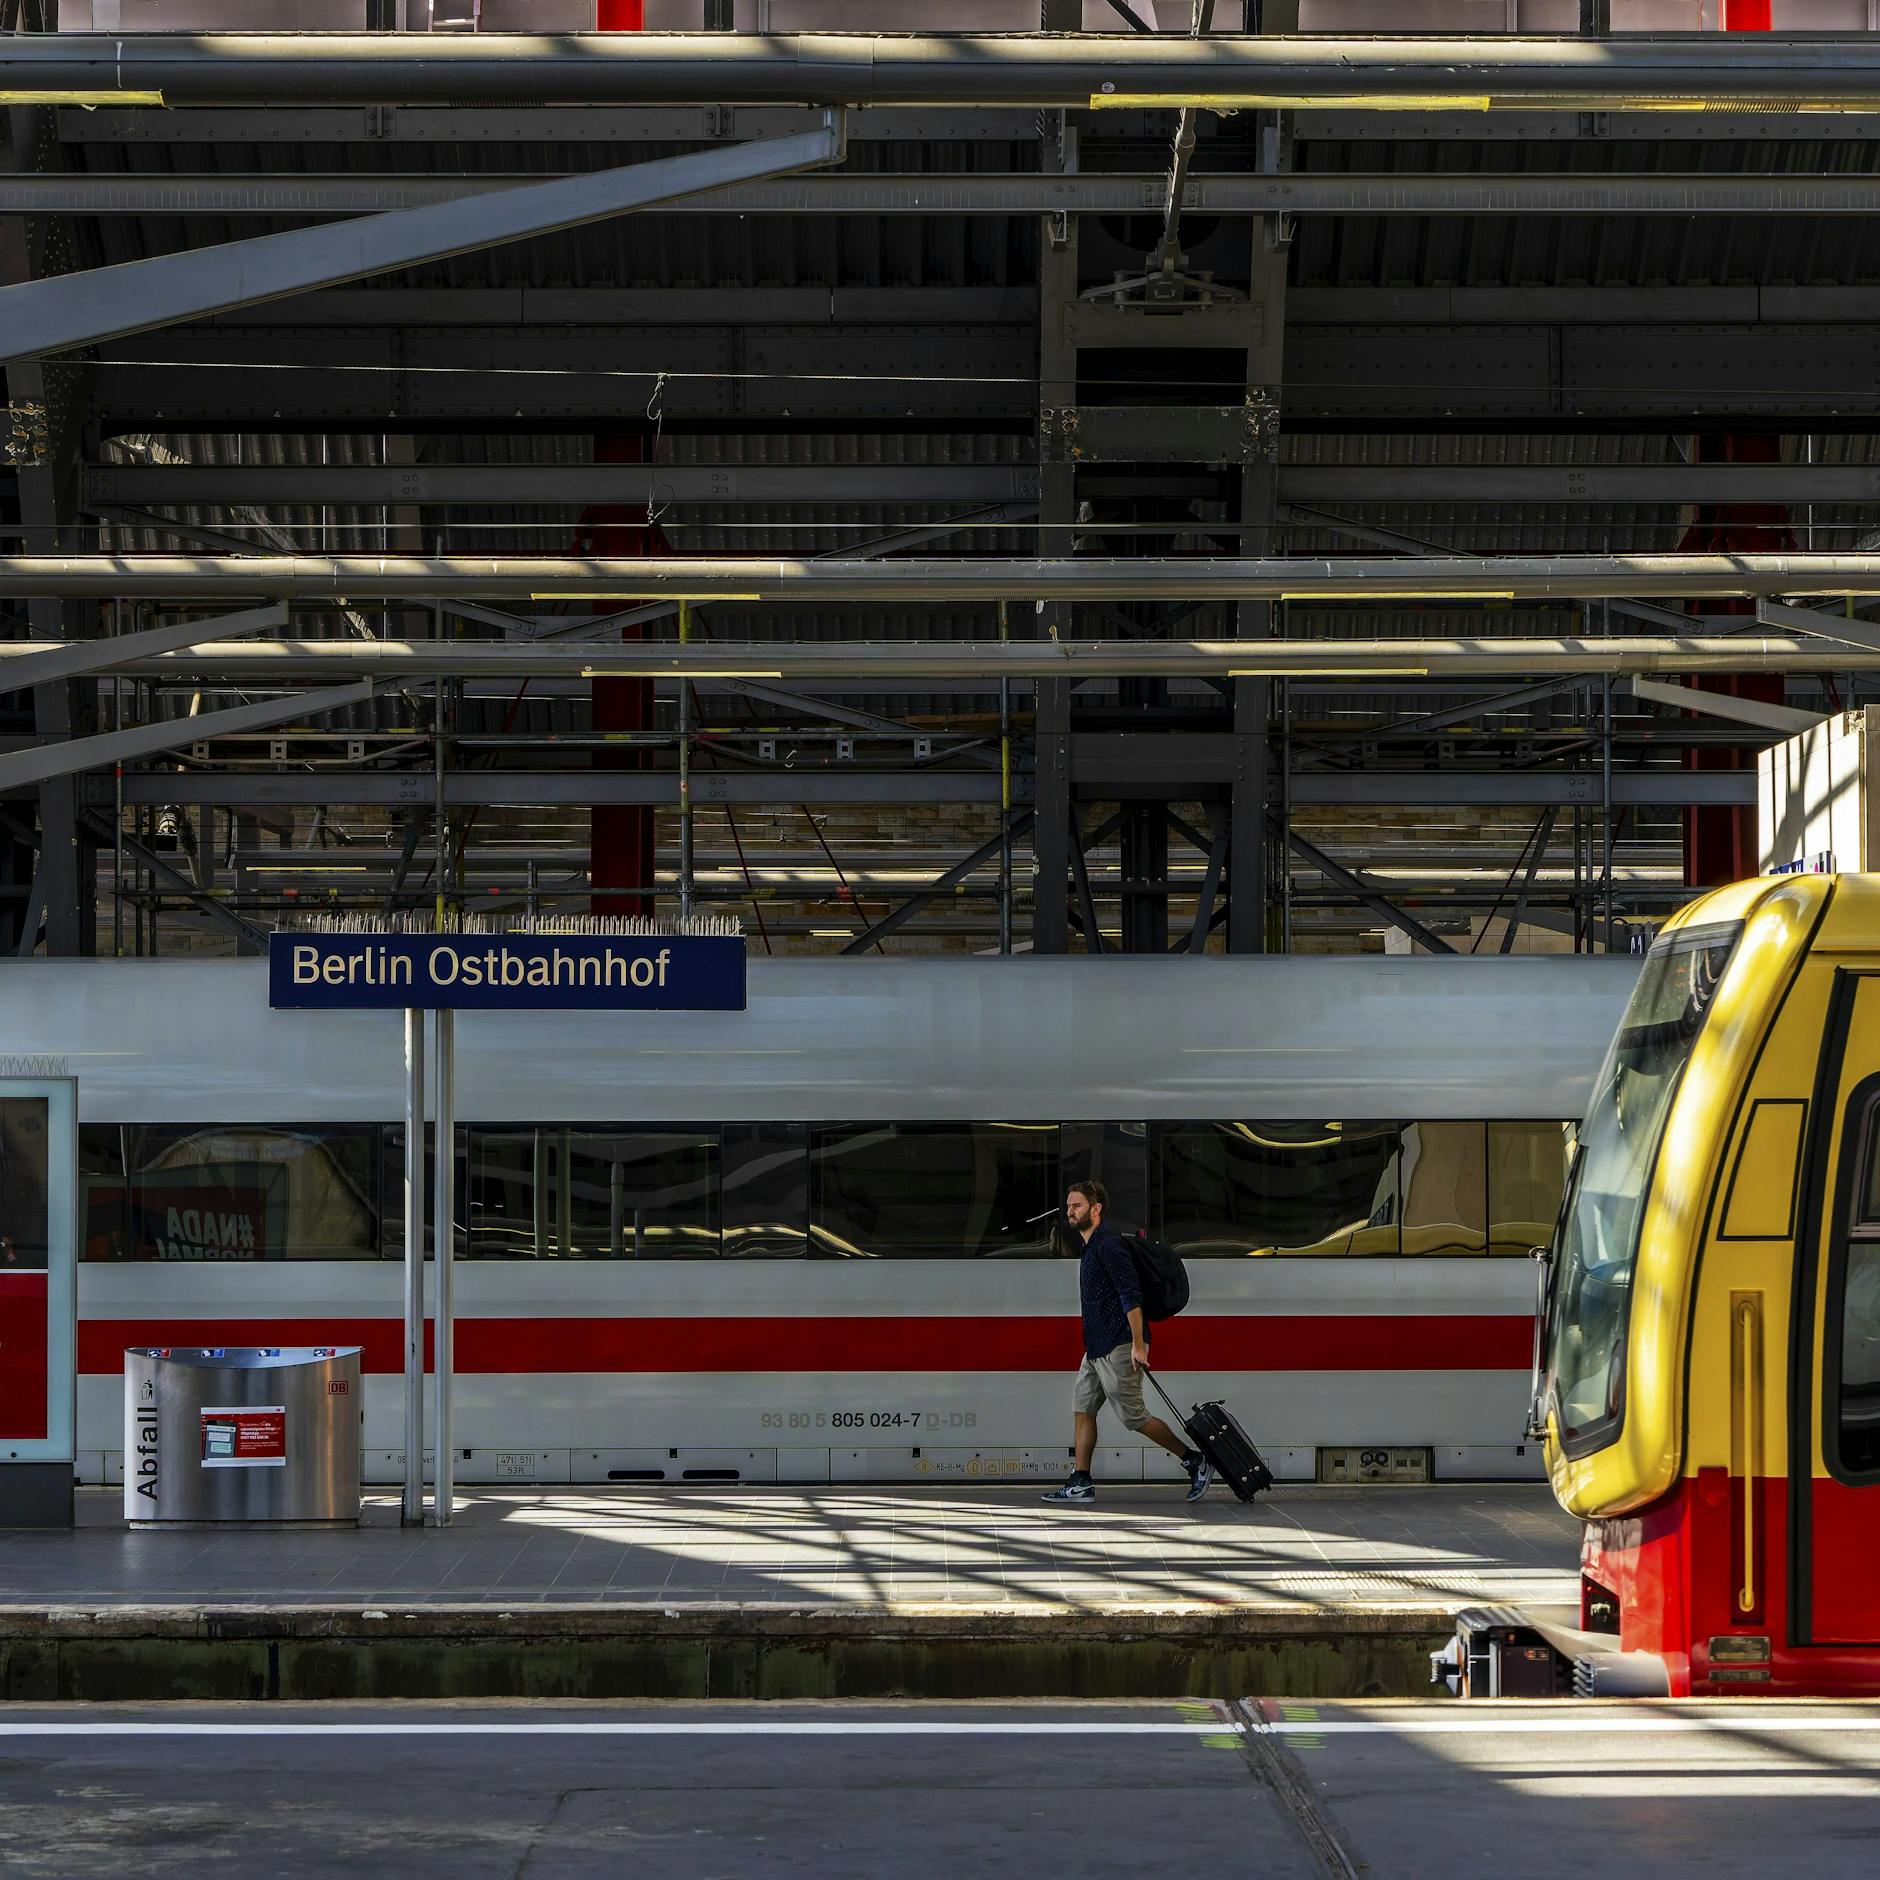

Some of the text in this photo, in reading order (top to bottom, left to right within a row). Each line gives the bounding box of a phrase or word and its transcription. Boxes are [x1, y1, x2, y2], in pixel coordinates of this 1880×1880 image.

[293, 946, 670, 987] Berlin Ostbahnhof
[330, 1382, 347, 1394] DB
[760, 1412, 977, 1430] 93 80 5 805 024-7 D-DB
[137, 1407, 158, 1501] Abfall
